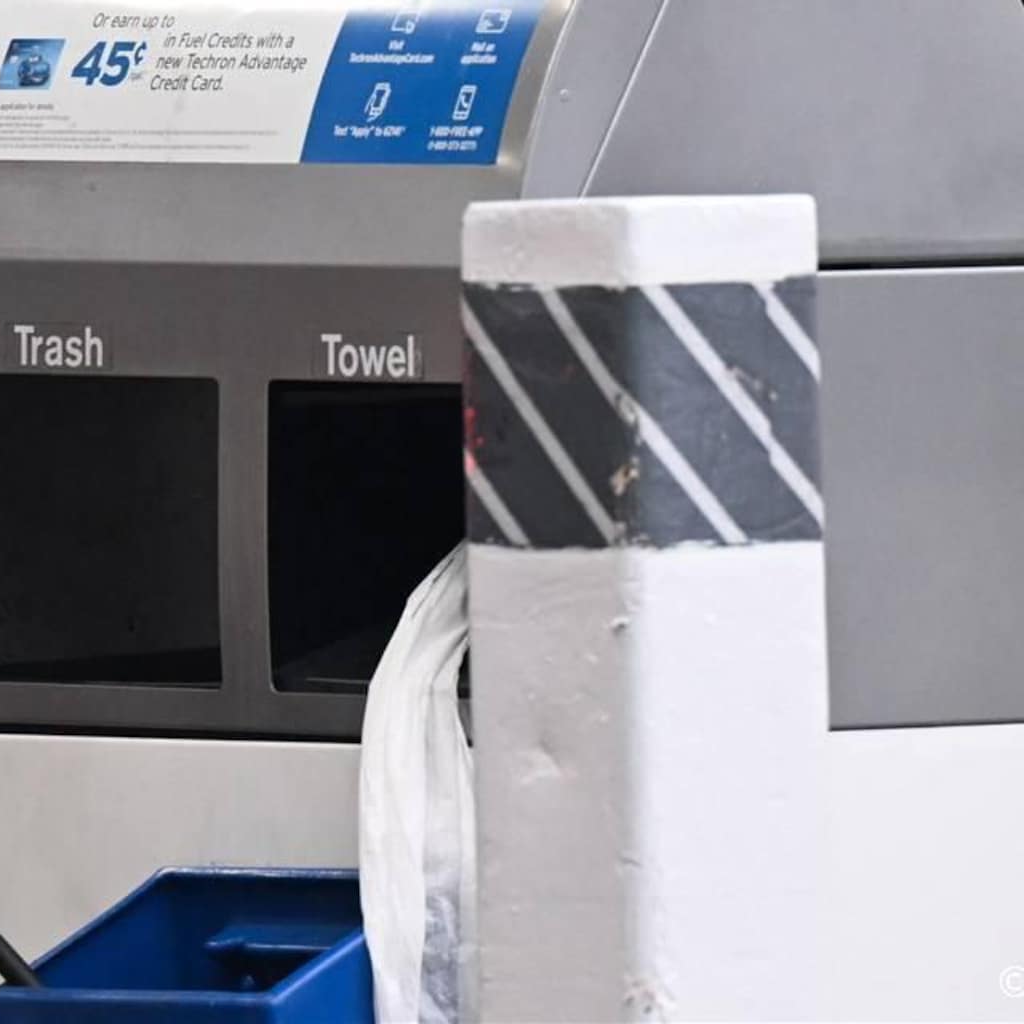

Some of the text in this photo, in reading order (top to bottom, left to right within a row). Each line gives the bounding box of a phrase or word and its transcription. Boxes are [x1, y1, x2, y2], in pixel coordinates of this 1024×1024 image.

[92, 13, 176, 31] Or earn up to
[163, 32, 295, 49] in Fuel Credits with a
[156, 53, 308, 72] new Techron Advantage
[150, 75, 189, 91] Credit
[191, 75, 224, 91] Card.
[13, 324, 104, 368] Trash
[320, 333, 416, 377] Towel
